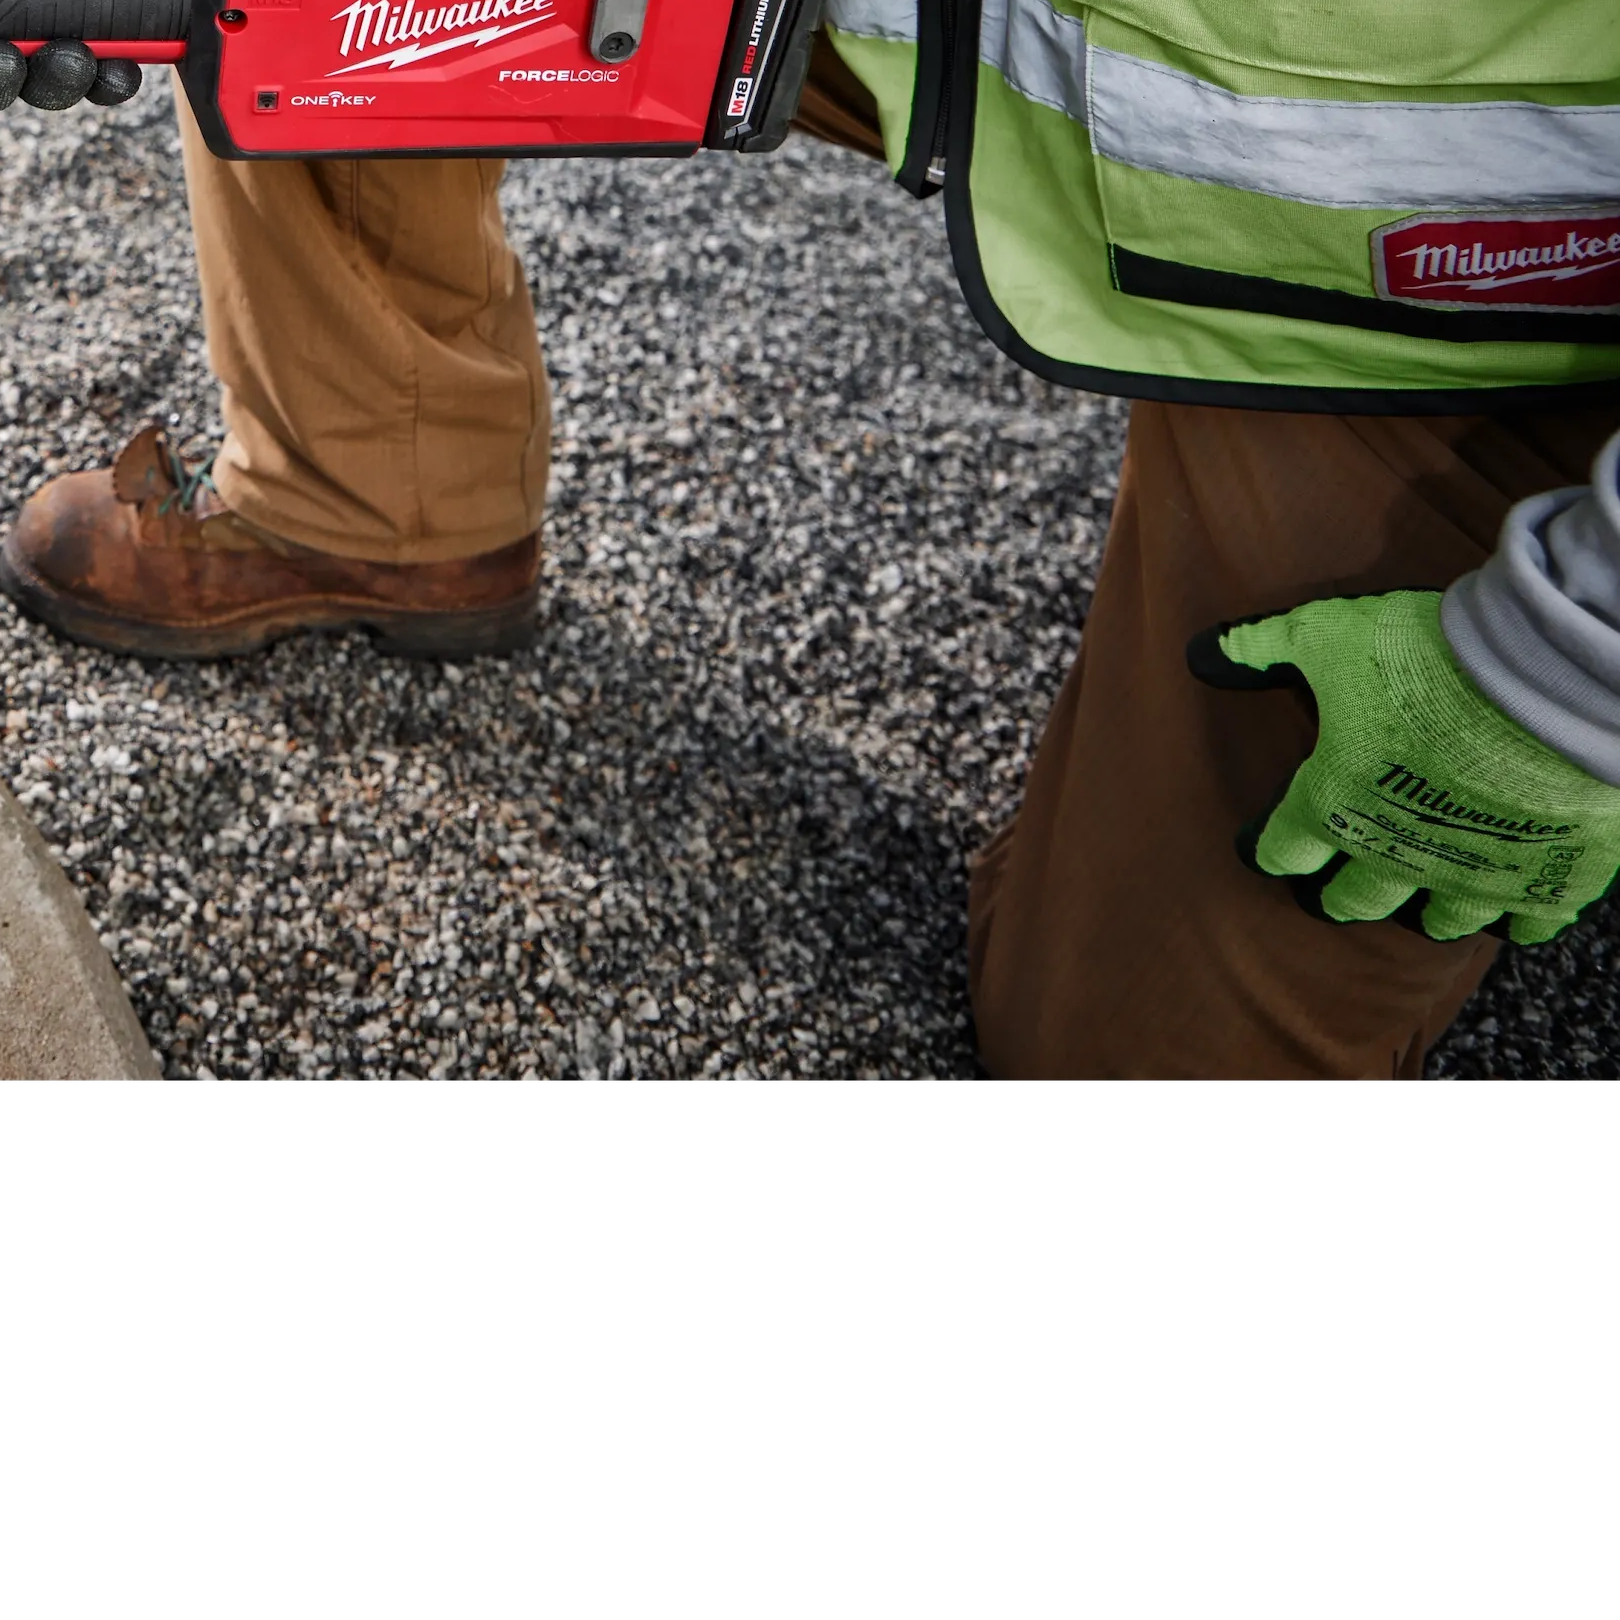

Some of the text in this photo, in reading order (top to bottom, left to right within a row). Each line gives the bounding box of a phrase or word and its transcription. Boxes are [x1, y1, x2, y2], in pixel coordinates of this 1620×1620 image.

[498, 69, 620, 83] FORCELOGIC
[731, 79, 749, 115] M18
[1396, 231, 1620, 280] Milwaukee
[1377, 761, 1573, 835] Milwaukee
